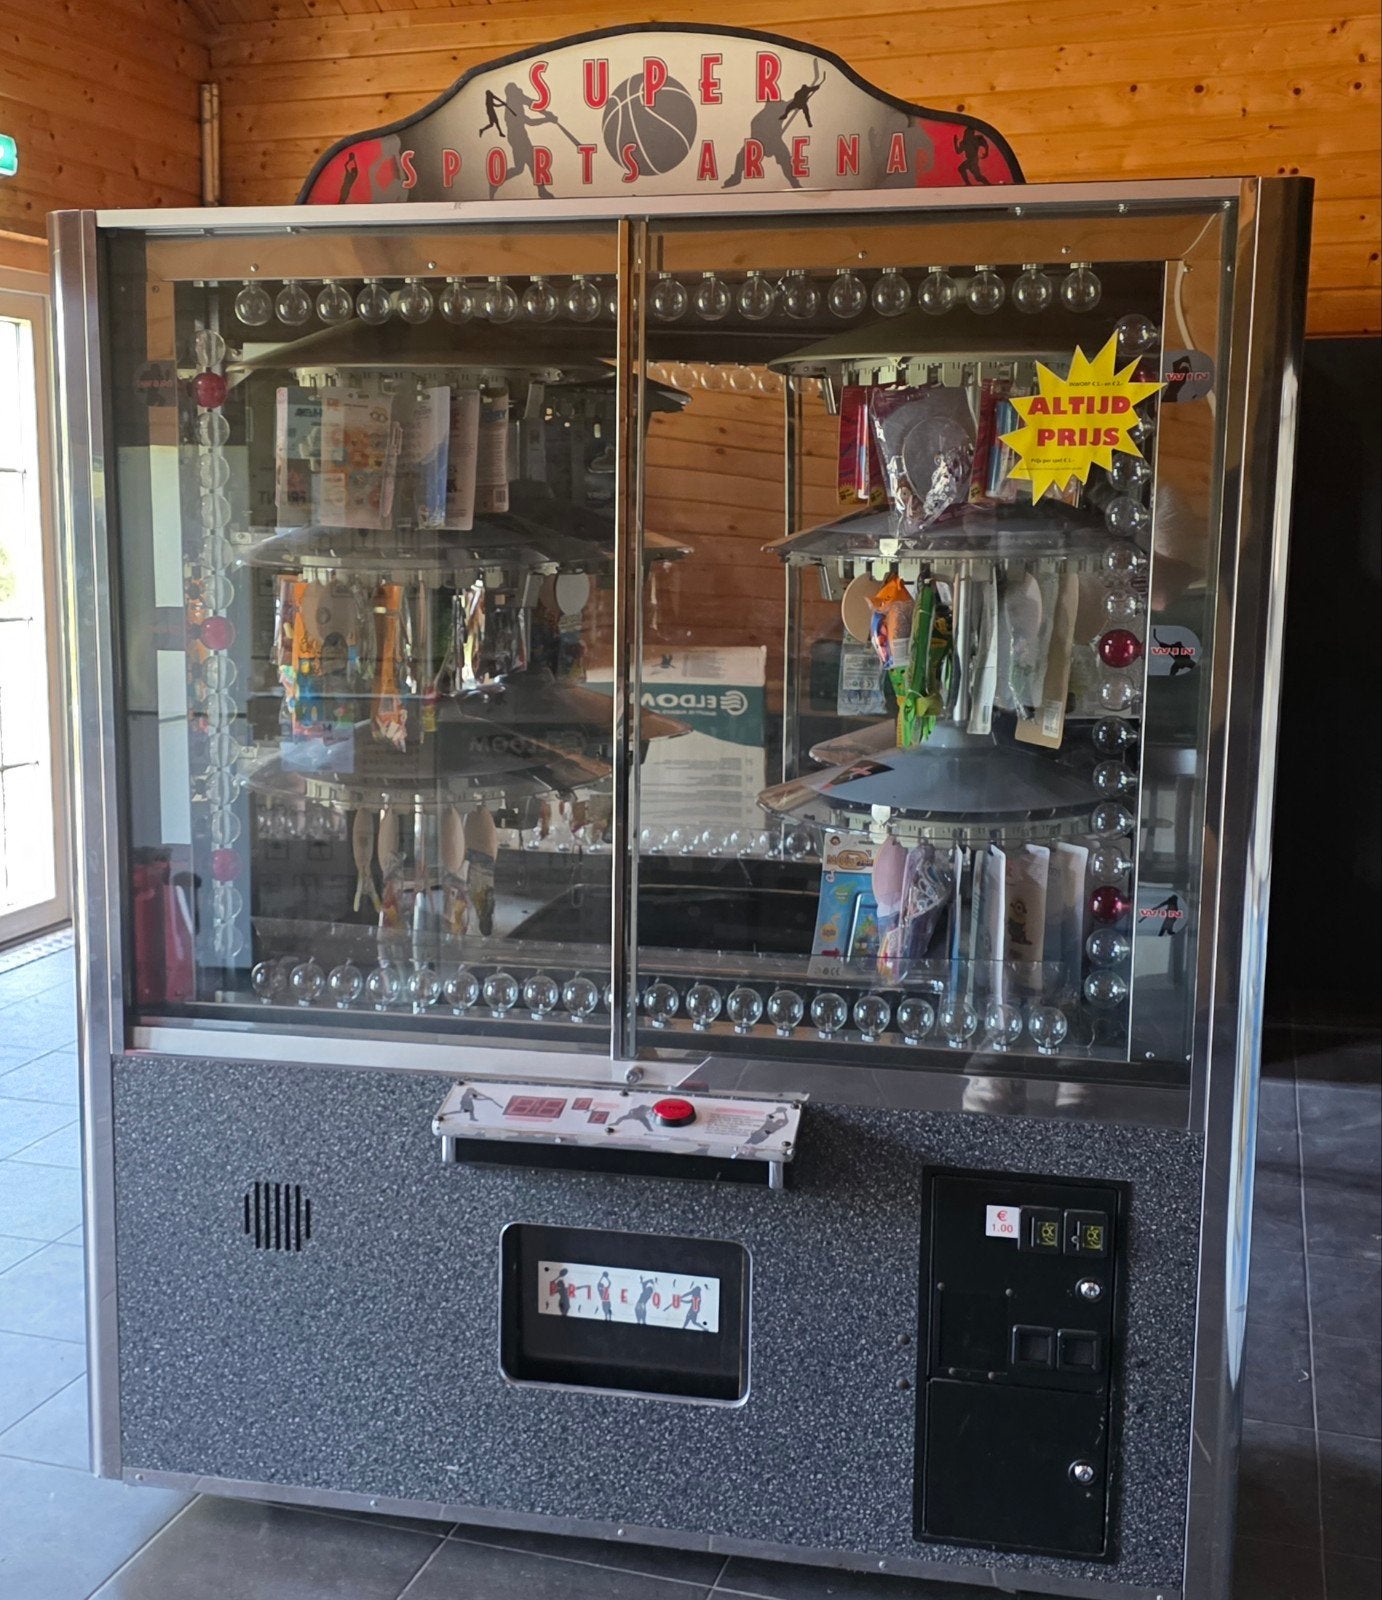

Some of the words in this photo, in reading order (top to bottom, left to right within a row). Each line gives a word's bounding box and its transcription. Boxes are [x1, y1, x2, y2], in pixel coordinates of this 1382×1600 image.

[528, 50, 783, 112] SUPER
[401, 143, 640, 189] SPORTS
[697, 132, 908, 181] ARENA
[1166, 372, 1209, 382] WIN
[1028, 396, 1131, 415] ALTIJD
[1037, 428, 1120, 447] PRIJS
[1151, 647, 1195, 655] WIN
[1139, 909, 1183, 918] WIN
[997, 1211, 1008, 1221] €
[993, 1224, 1013, 1233] 1.00
[652, 1292, 702, 1312] OUT
